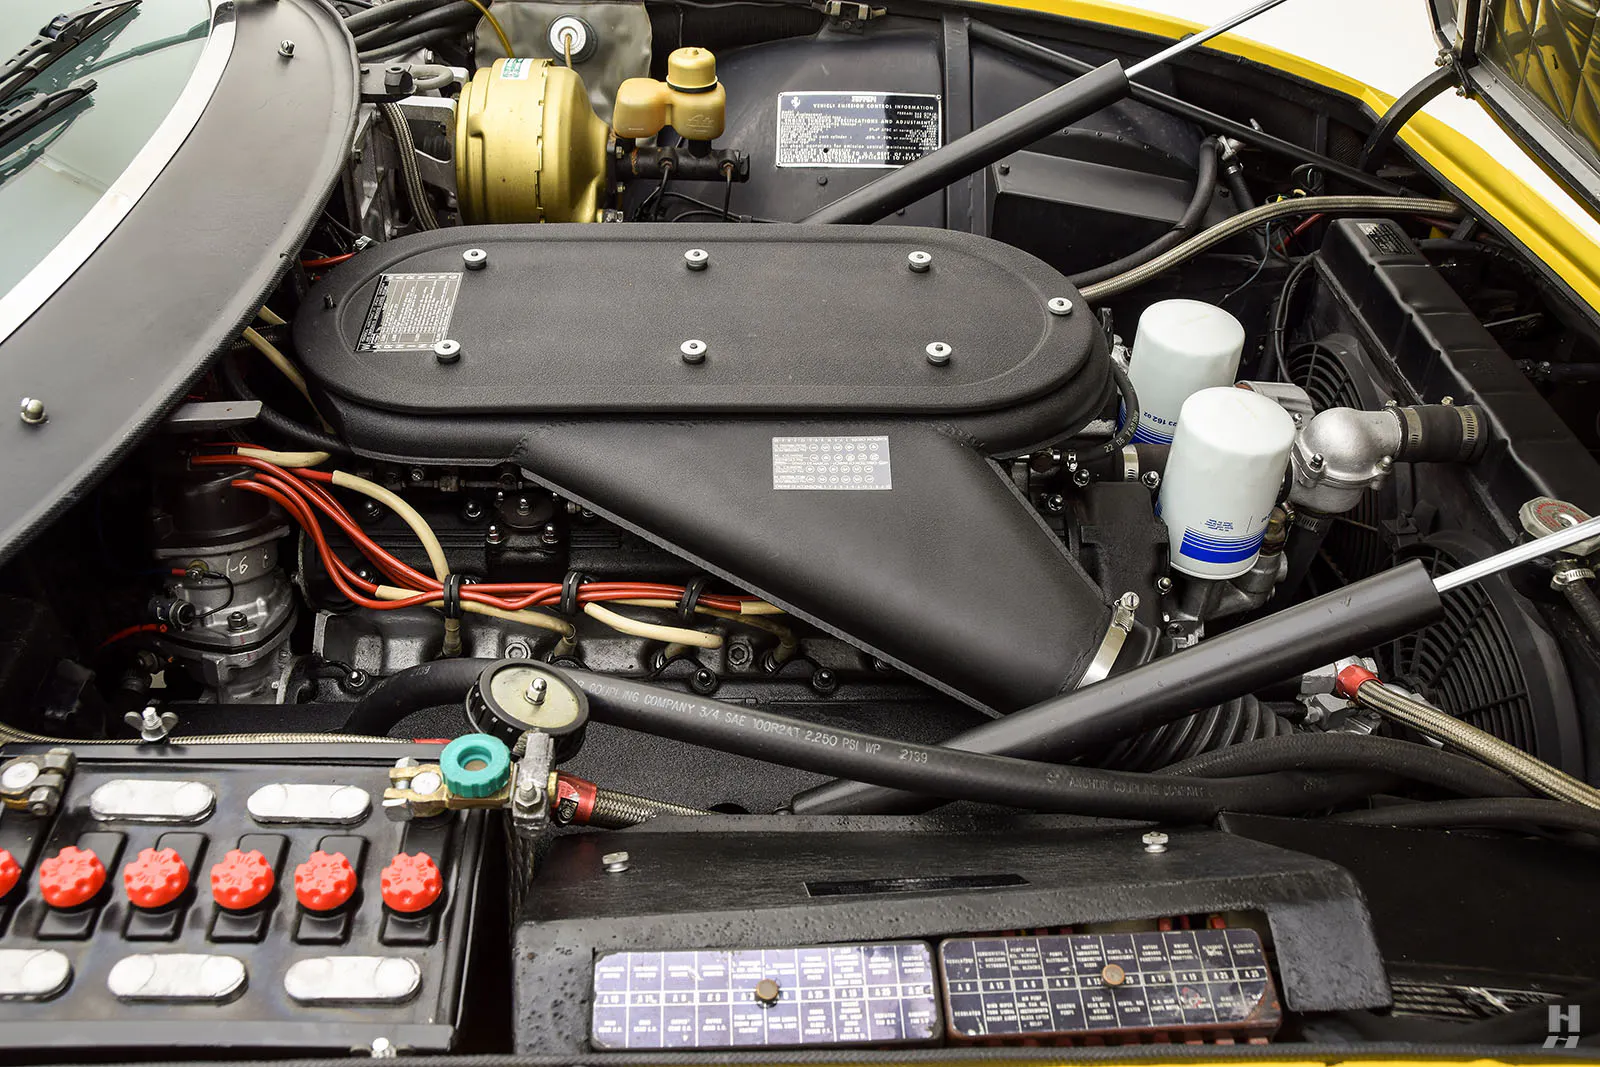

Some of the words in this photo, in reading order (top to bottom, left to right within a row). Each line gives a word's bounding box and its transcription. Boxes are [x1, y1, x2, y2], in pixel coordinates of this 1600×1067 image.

[644, 694, 696, 714] COMPANY
[700, 706, 720, 720] 3/4
[725, 712, 747, 727] SAE
[753, 718, 800, 738] 100R2AT
[805, 730, 838, 747] 2.250
[842, 737, 859, 751] PSI
[865, 742, 881, 755] WP
[900, 749, 928, 764] 2139
[672, 994, 678, 1002] A
[808, 990, 814, 999] A
[841, 989, 847, 998] A
